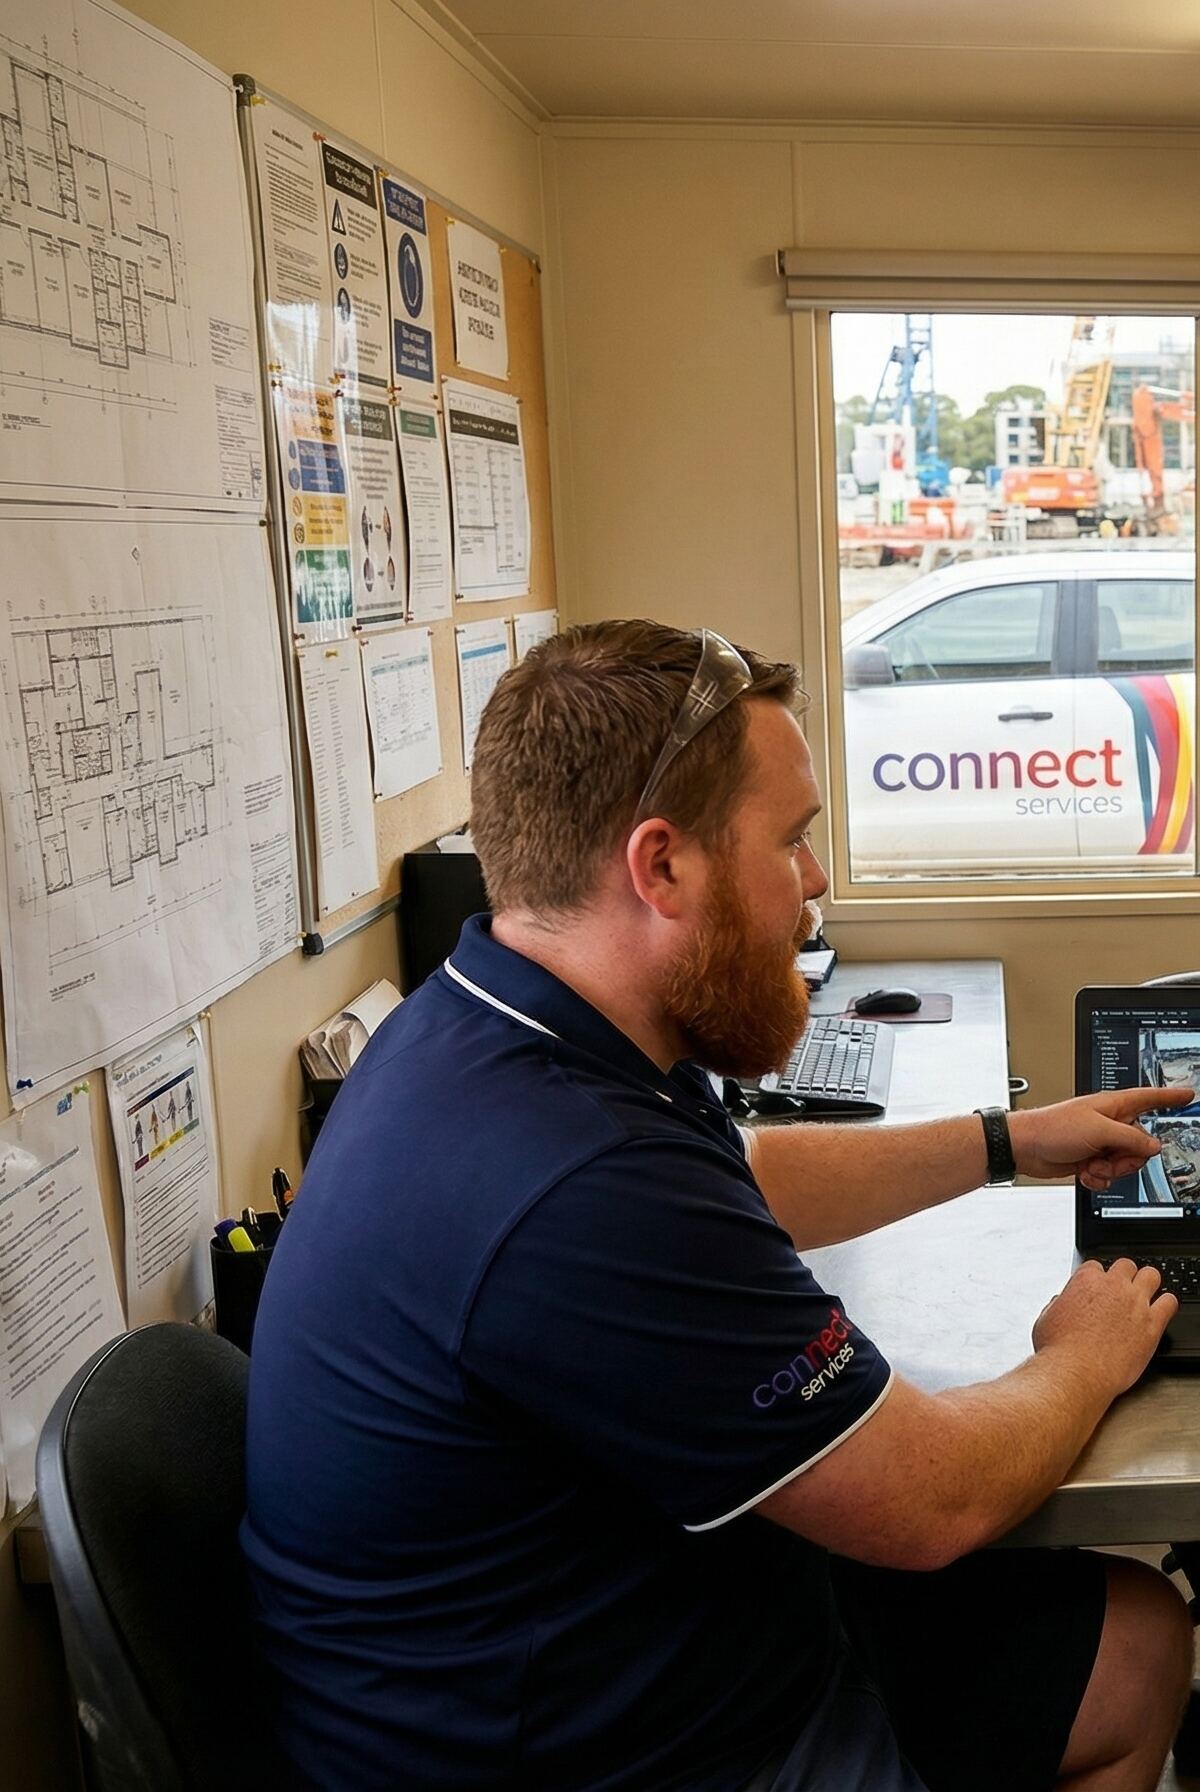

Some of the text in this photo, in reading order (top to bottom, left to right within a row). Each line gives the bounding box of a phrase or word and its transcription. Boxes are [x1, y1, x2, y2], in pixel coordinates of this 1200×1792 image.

[872, 739, 1123, 792] connect
[1015, 794, 1123, 815] services
[801, 1341, 855, 1401] services
